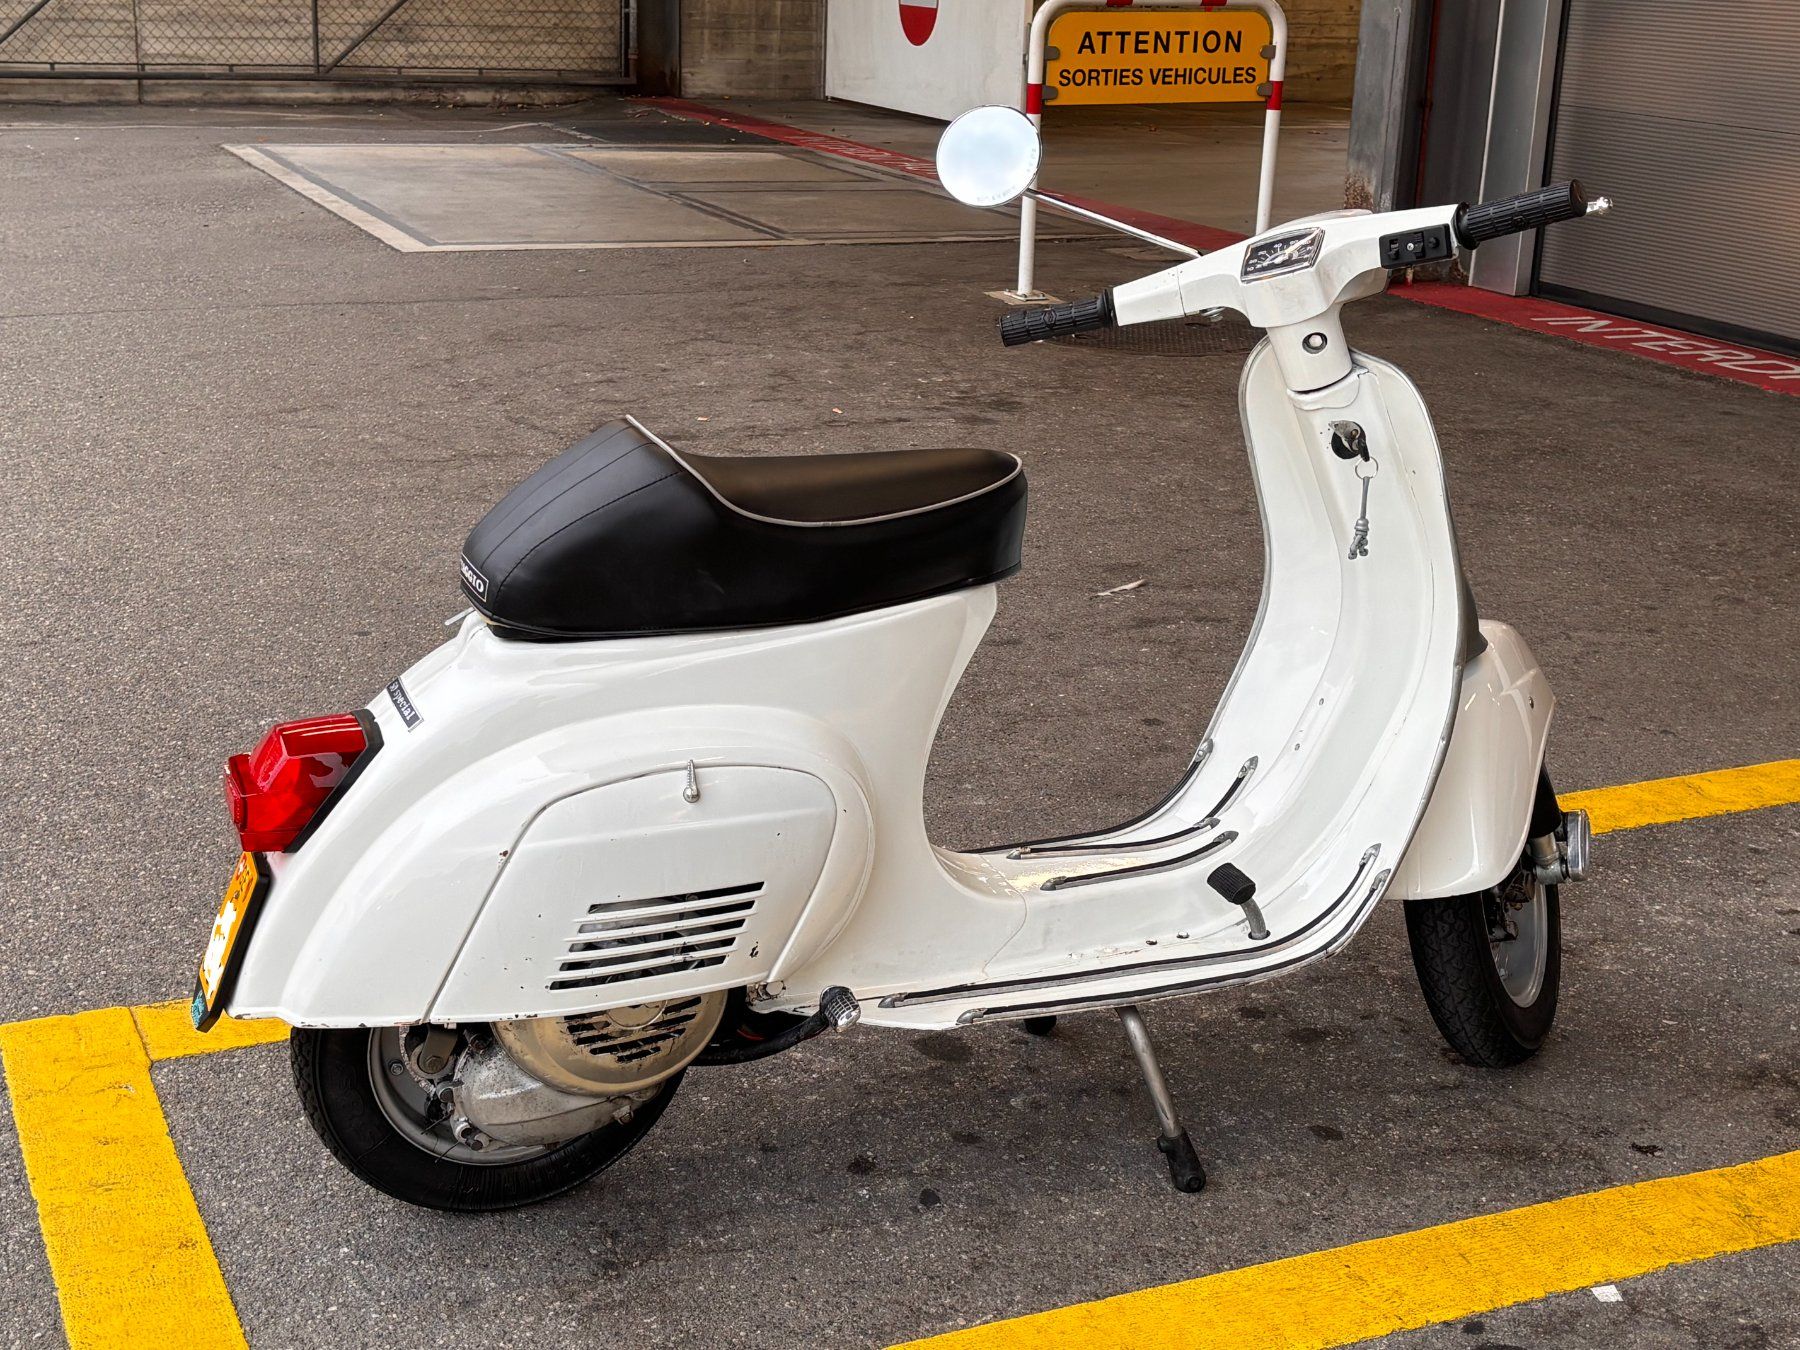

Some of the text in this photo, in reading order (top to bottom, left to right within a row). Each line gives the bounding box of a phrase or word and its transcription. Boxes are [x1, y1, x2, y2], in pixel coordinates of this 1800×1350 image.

[1077, 30, 1242, 54] ATTENTION
[1059, 66, 1257, 87] SORTIES VEHICULES
[393, 690, 415, 721] special
